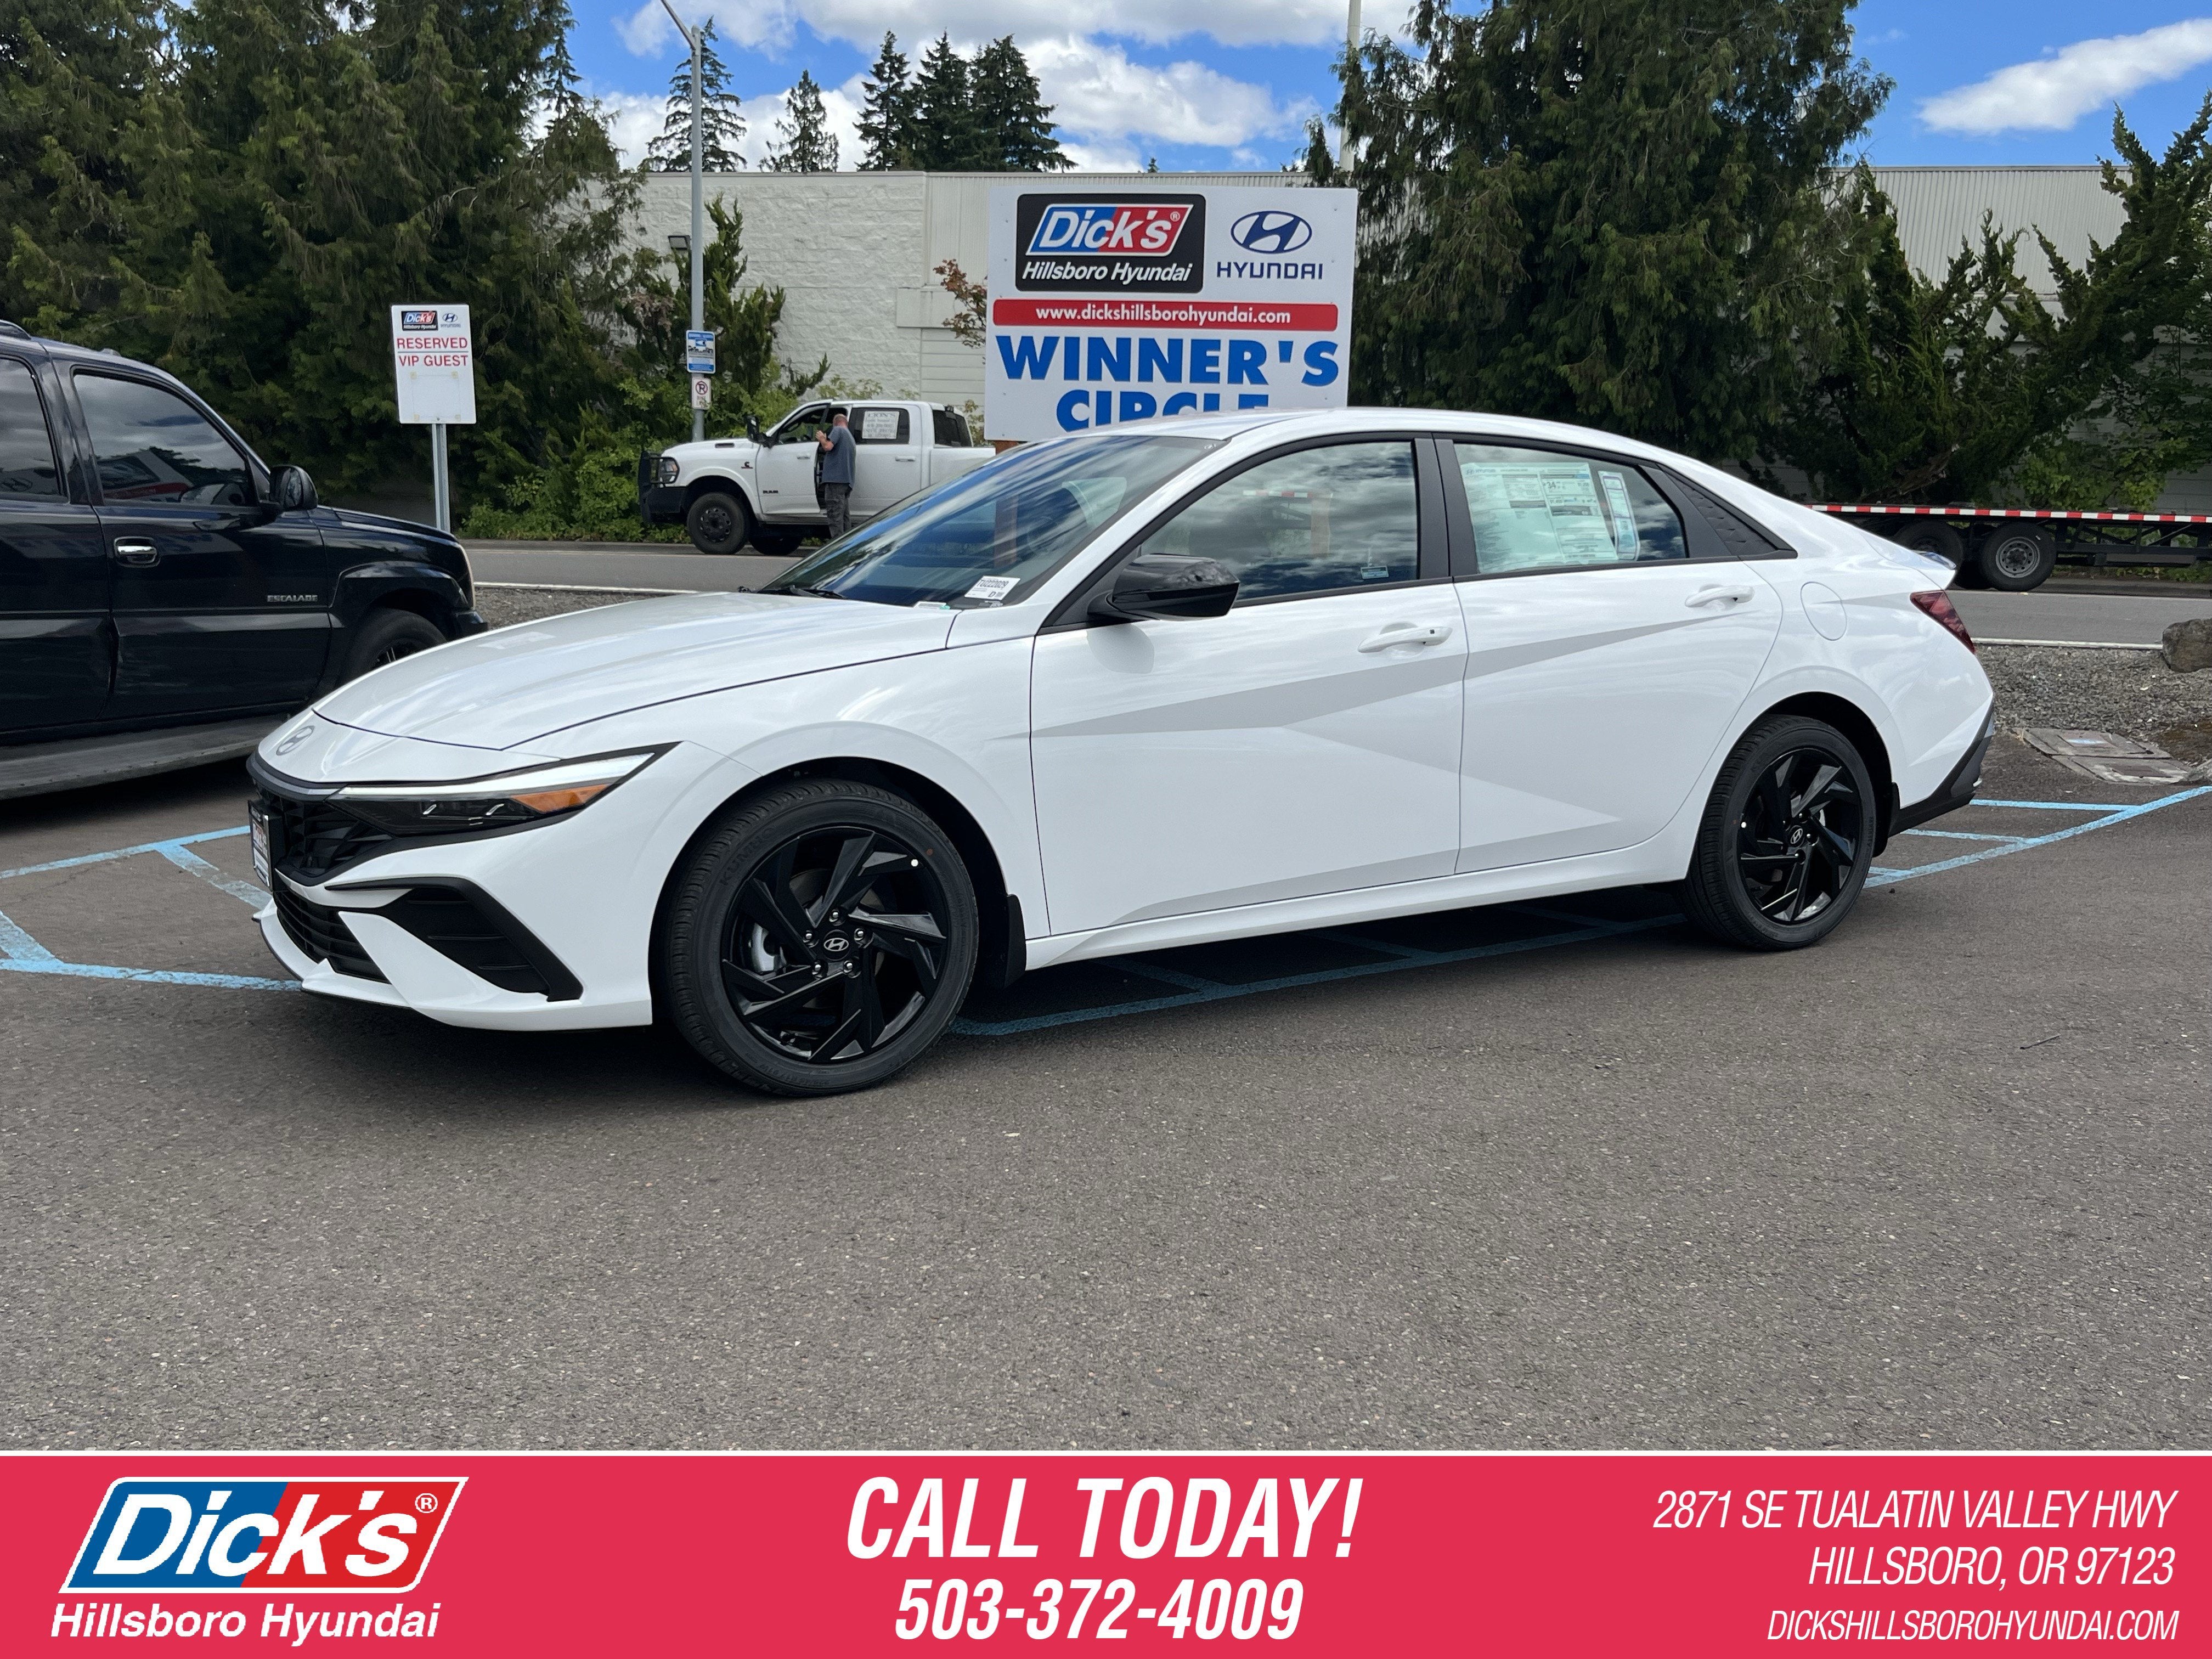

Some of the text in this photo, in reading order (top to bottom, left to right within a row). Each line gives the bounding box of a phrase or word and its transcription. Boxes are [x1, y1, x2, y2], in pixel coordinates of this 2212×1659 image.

[1038, 210, 1172, 249] Dick's
[1022, 261, 1193, 285] Hillsboro Hyundai
[1217, 262, 1323, 280] HYUNDAI
[1036, 303, 1291, 326] www.dickshillsborohyundai.com
[397, 337, 468, 349] RESERVED
[399, 355, 469, 366] VIP GUEST
[995, 335, 1339, 387] WINNER'S
[267, 594, 318, 602] ESCALADE
